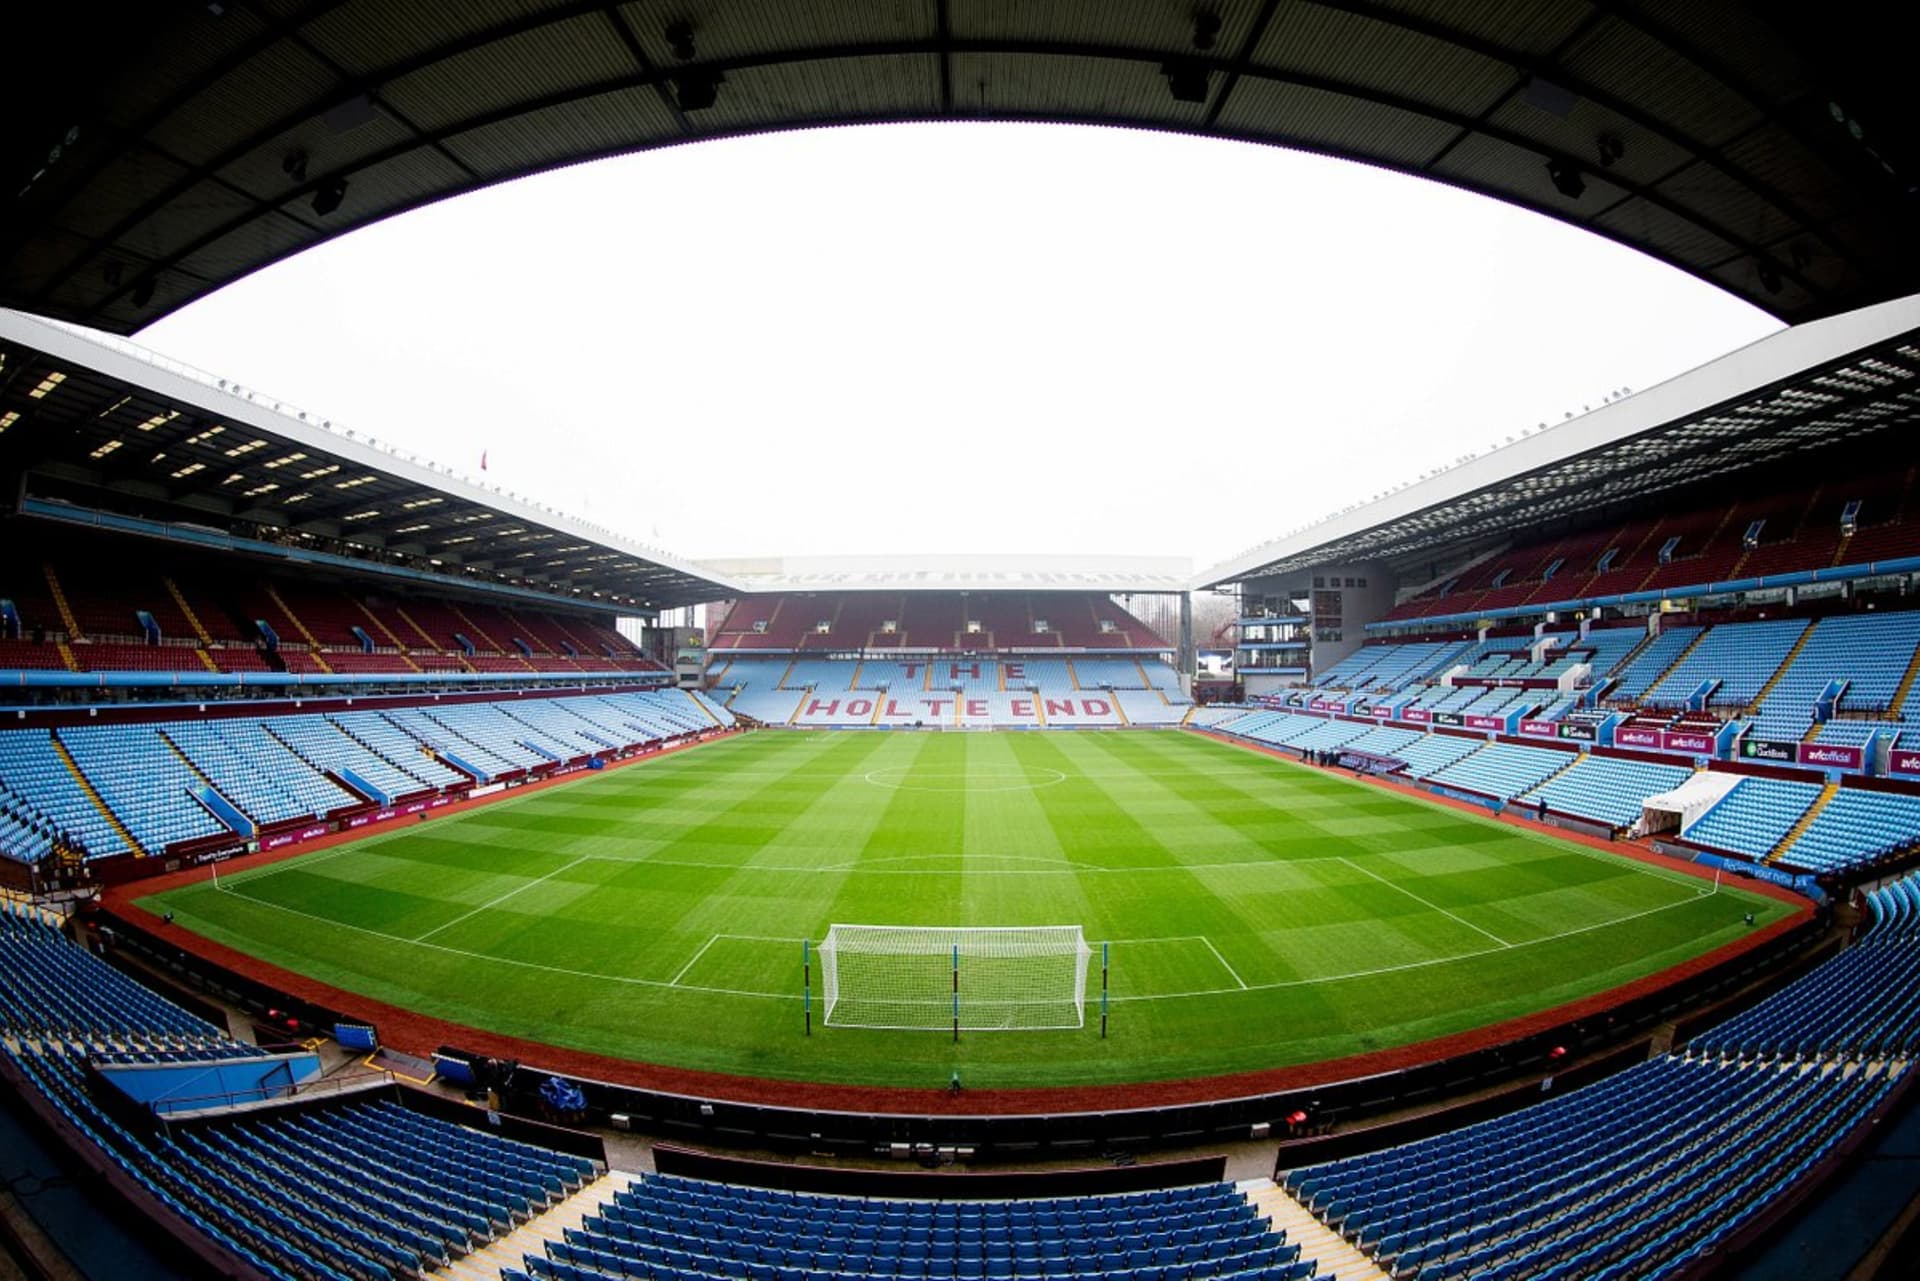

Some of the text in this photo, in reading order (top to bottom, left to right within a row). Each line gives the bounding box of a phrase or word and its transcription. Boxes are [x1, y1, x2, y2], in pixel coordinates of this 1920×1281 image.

[898, 662, 1026, 680] THE
[805, 698, 1112, 717] HOLTE END
